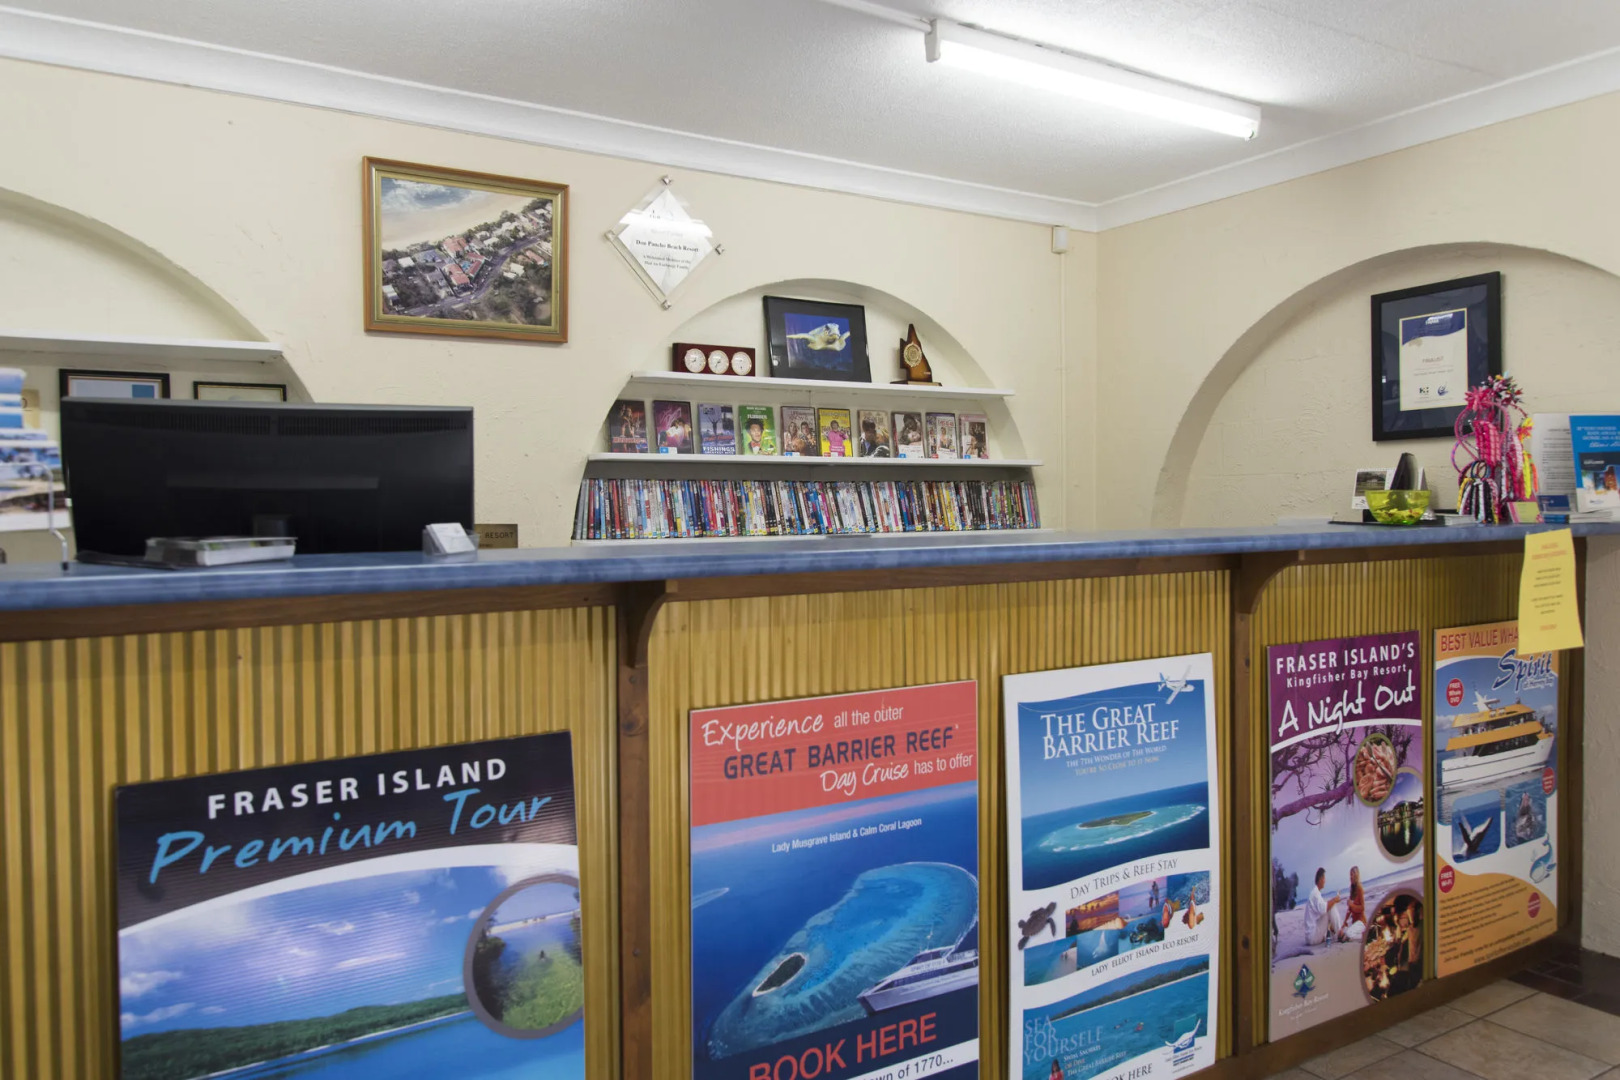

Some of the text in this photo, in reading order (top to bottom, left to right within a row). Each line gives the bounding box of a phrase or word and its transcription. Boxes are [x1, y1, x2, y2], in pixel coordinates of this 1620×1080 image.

[1276, 642, 1415, 675] FRASER ISLAND'S
[1441, 633, 1466, 652] BEST
[1468, 629, 1498, 649] VALUE
[1286, 663, 1407, 688] Kingfisher Bay Resort
[1492, 648, 1553, 693] Spirit
[1040, 703, 1156, 738] THE GREAT
[1278, 669, 1416, 737] A Night Out
[701, 705, 904, 751] Experience all the outer
[1043, 719, 1180, 760] BARRIER REEF
[724, 726, 954, 780] GREAT BARRIER REEF
[820, 751, 973, 796] Day Cruise has to offer
[208, 758, 507, 820] FRASER ISLAND
[149, 788, 552, 885] Premium Tour
[772, 816, 922, 854] Lady Musgrave Island & Calm Coral Lagoon
[1070, 857, 1178, 900] DAY TRIPS & REEF STAY
[1091, 933, 1201, 977] LADY ELLIOT ISLAND ECO RESORT
[1025, 1014, 1053, 1035] SEA
[1025, 1027, 1058, 1050] FOR
[749, 1012, 937, 1080] BOOK HERE
[1023, 1025, 1103, 1066] YOURSELF
[898, 1065, 911, 1079] of
[914, 1054, 954, 1074] 1770...
[1128, 1063, 1153, 1080] HERE
